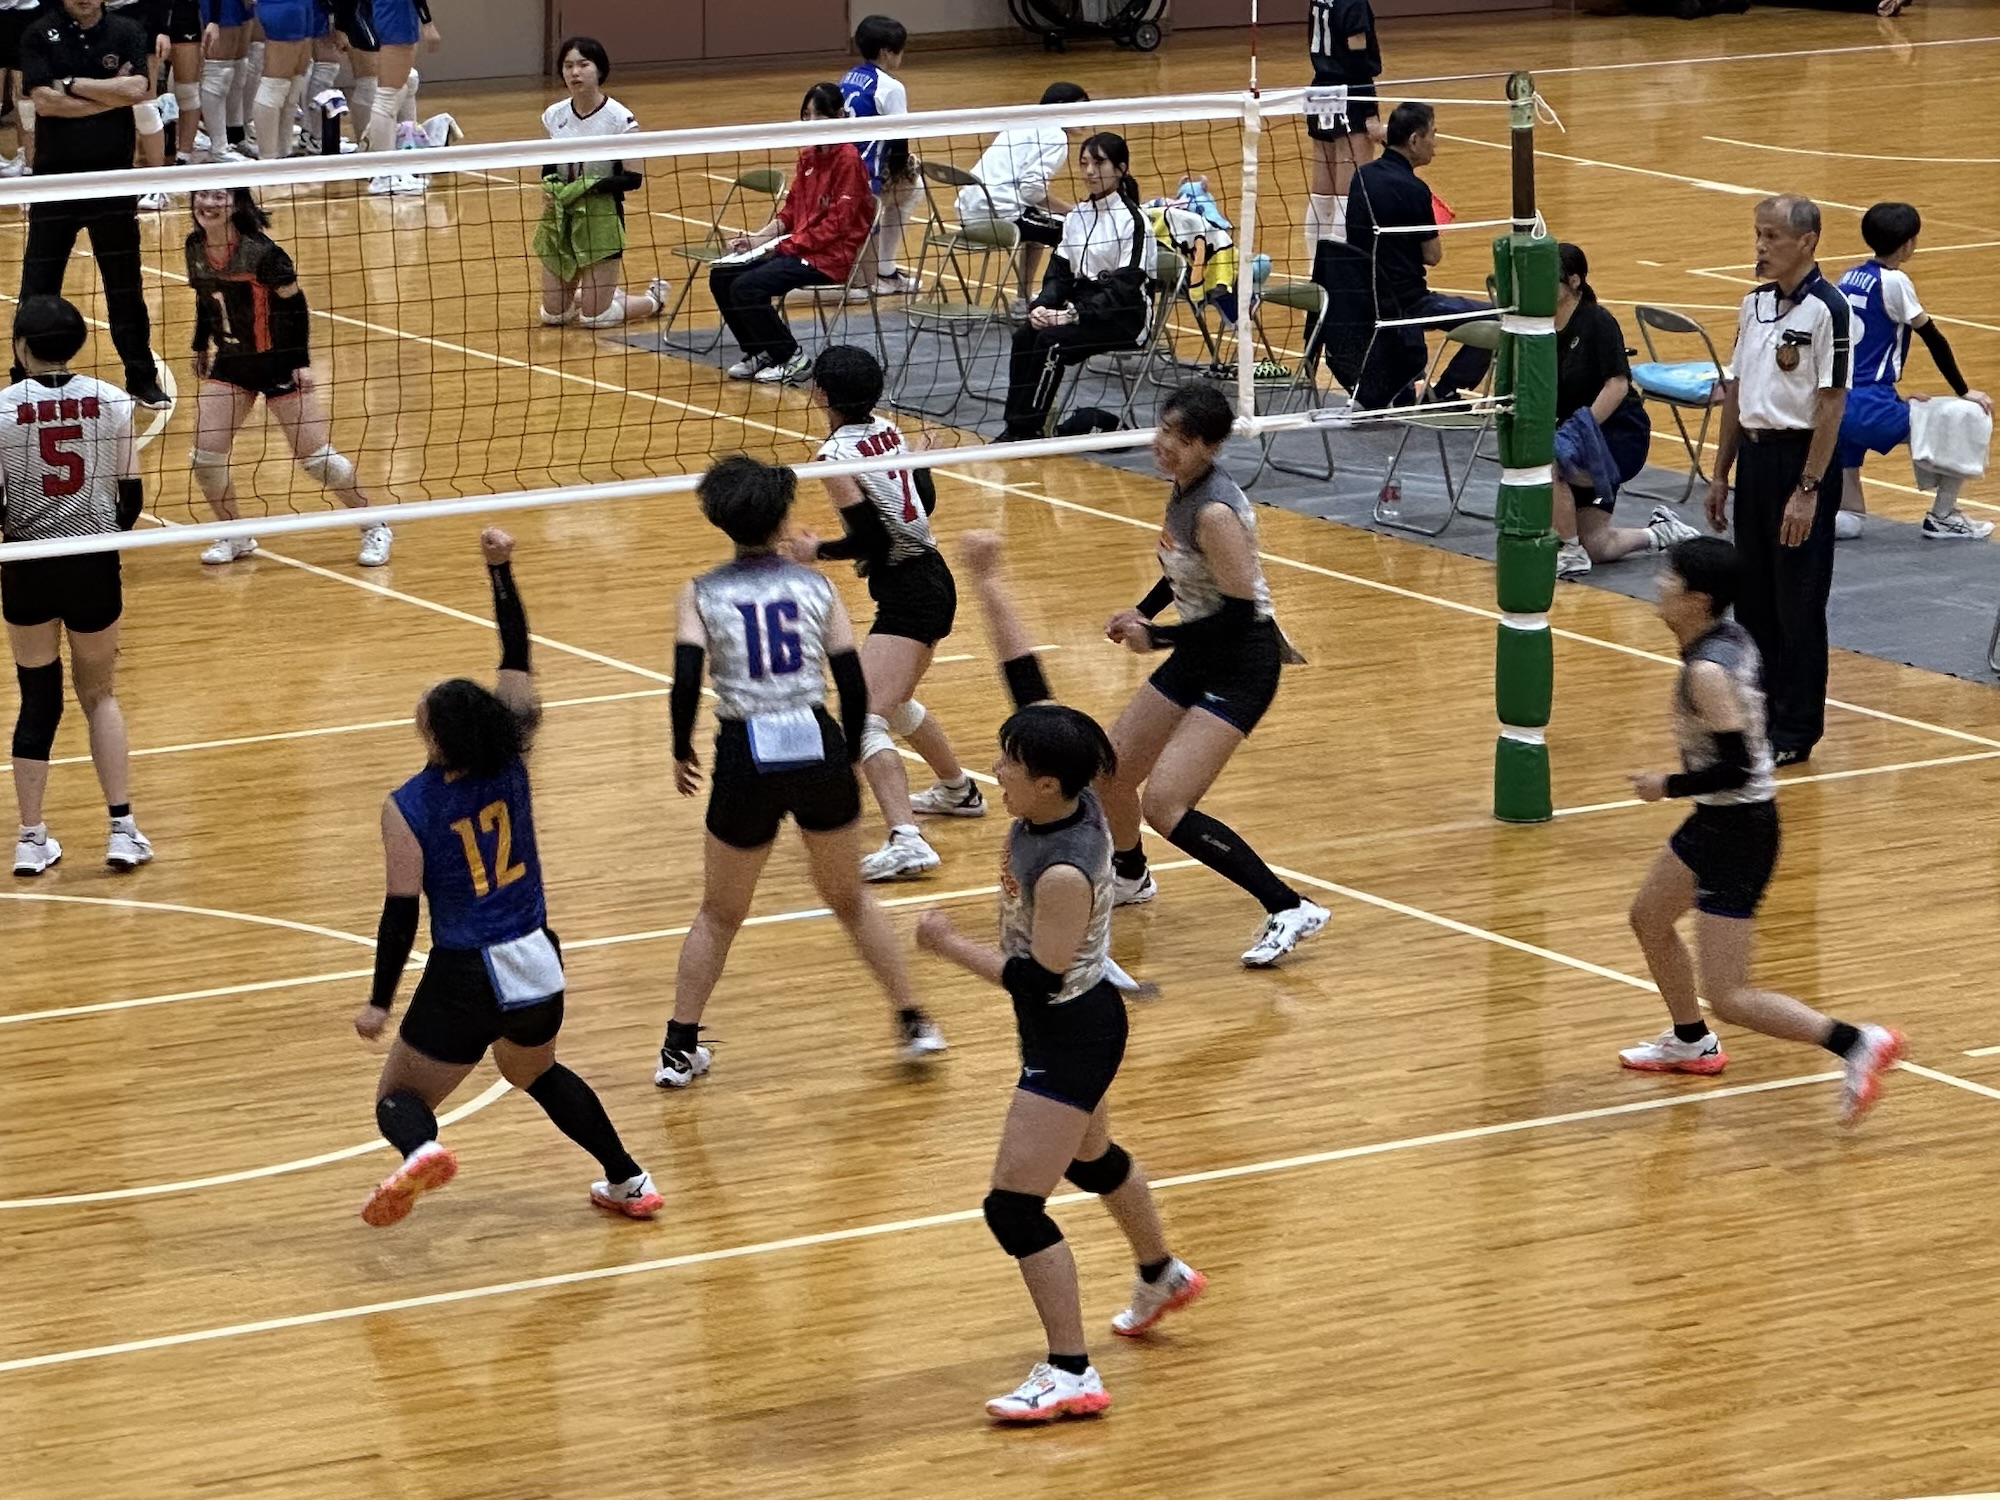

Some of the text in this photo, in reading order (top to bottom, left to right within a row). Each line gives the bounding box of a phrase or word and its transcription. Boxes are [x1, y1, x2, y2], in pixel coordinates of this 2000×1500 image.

[1311, 5, 1332, 56] 11
[39, 425, 85, 497] 5
[734, 600, 803, 679] 16
[450, 799, 526, 897] 12
